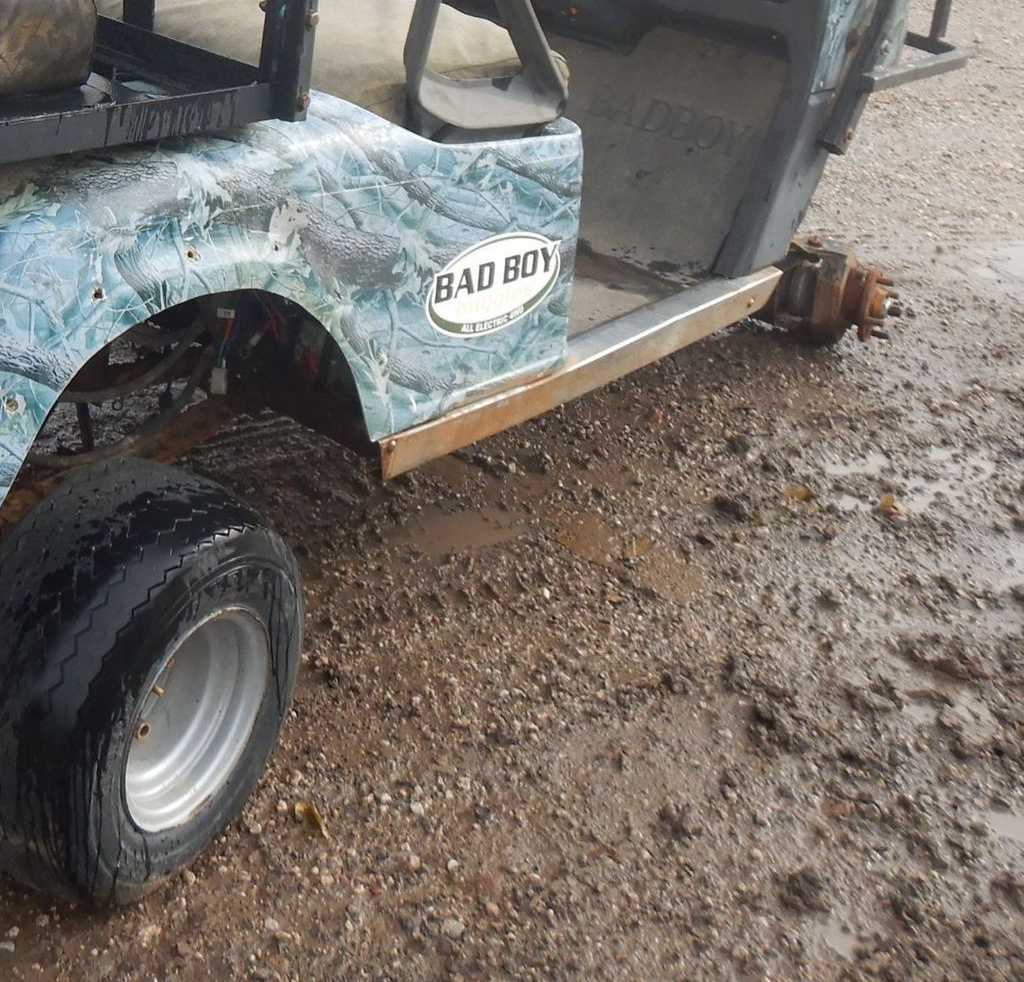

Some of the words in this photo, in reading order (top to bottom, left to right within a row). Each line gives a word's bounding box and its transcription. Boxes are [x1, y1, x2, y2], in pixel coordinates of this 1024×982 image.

[434, 261, 496, 304] BAD
[502, 244, 559, 285] BOY
[460, 323, 474, 333] ALL
[475, 314, 509, 332] ELECTRIC
